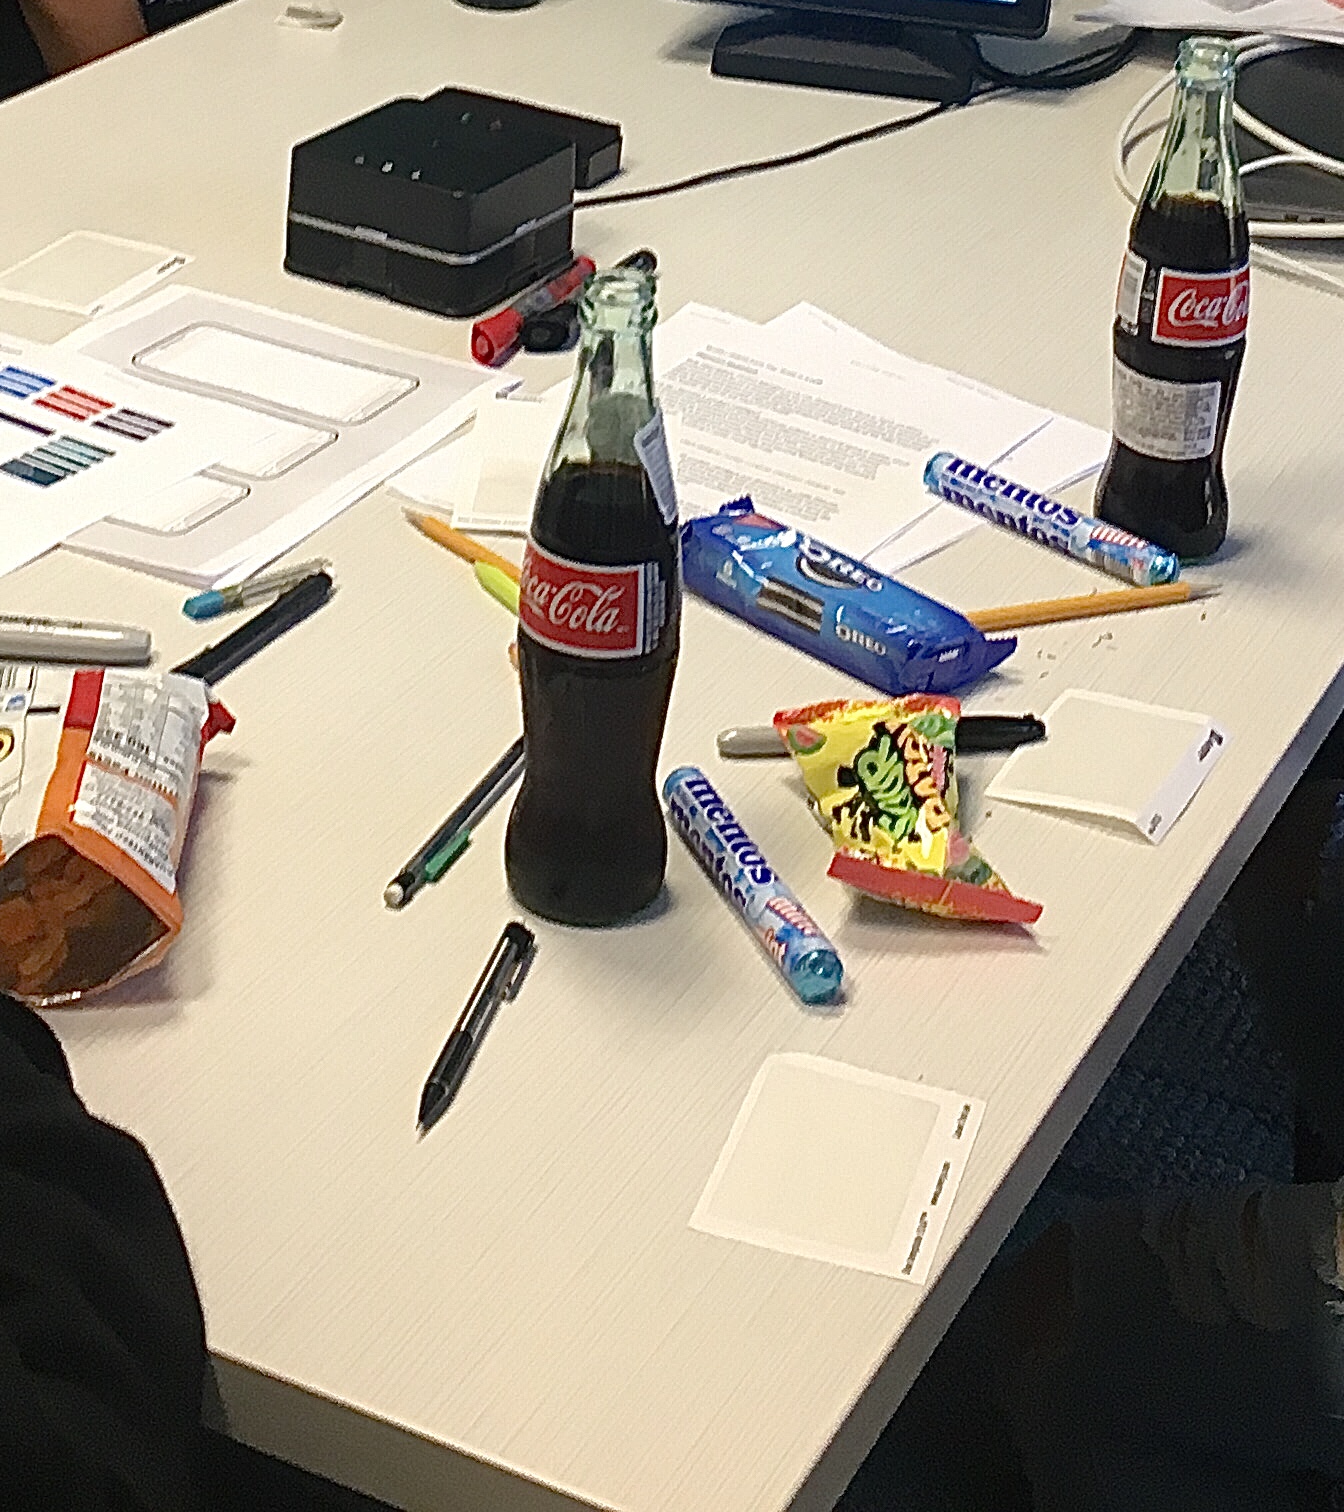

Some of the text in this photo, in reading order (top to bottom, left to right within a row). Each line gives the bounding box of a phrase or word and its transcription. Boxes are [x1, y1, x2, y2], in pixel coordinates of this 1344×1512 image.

[1167, 280, 1249, 328] Coca-Co
[945, 456, 1082, 528] mentos
[798, 534, 883, 593] OREO
[835, 623, 886, 656] OREO
[684, 777, 774, 885] mentos
